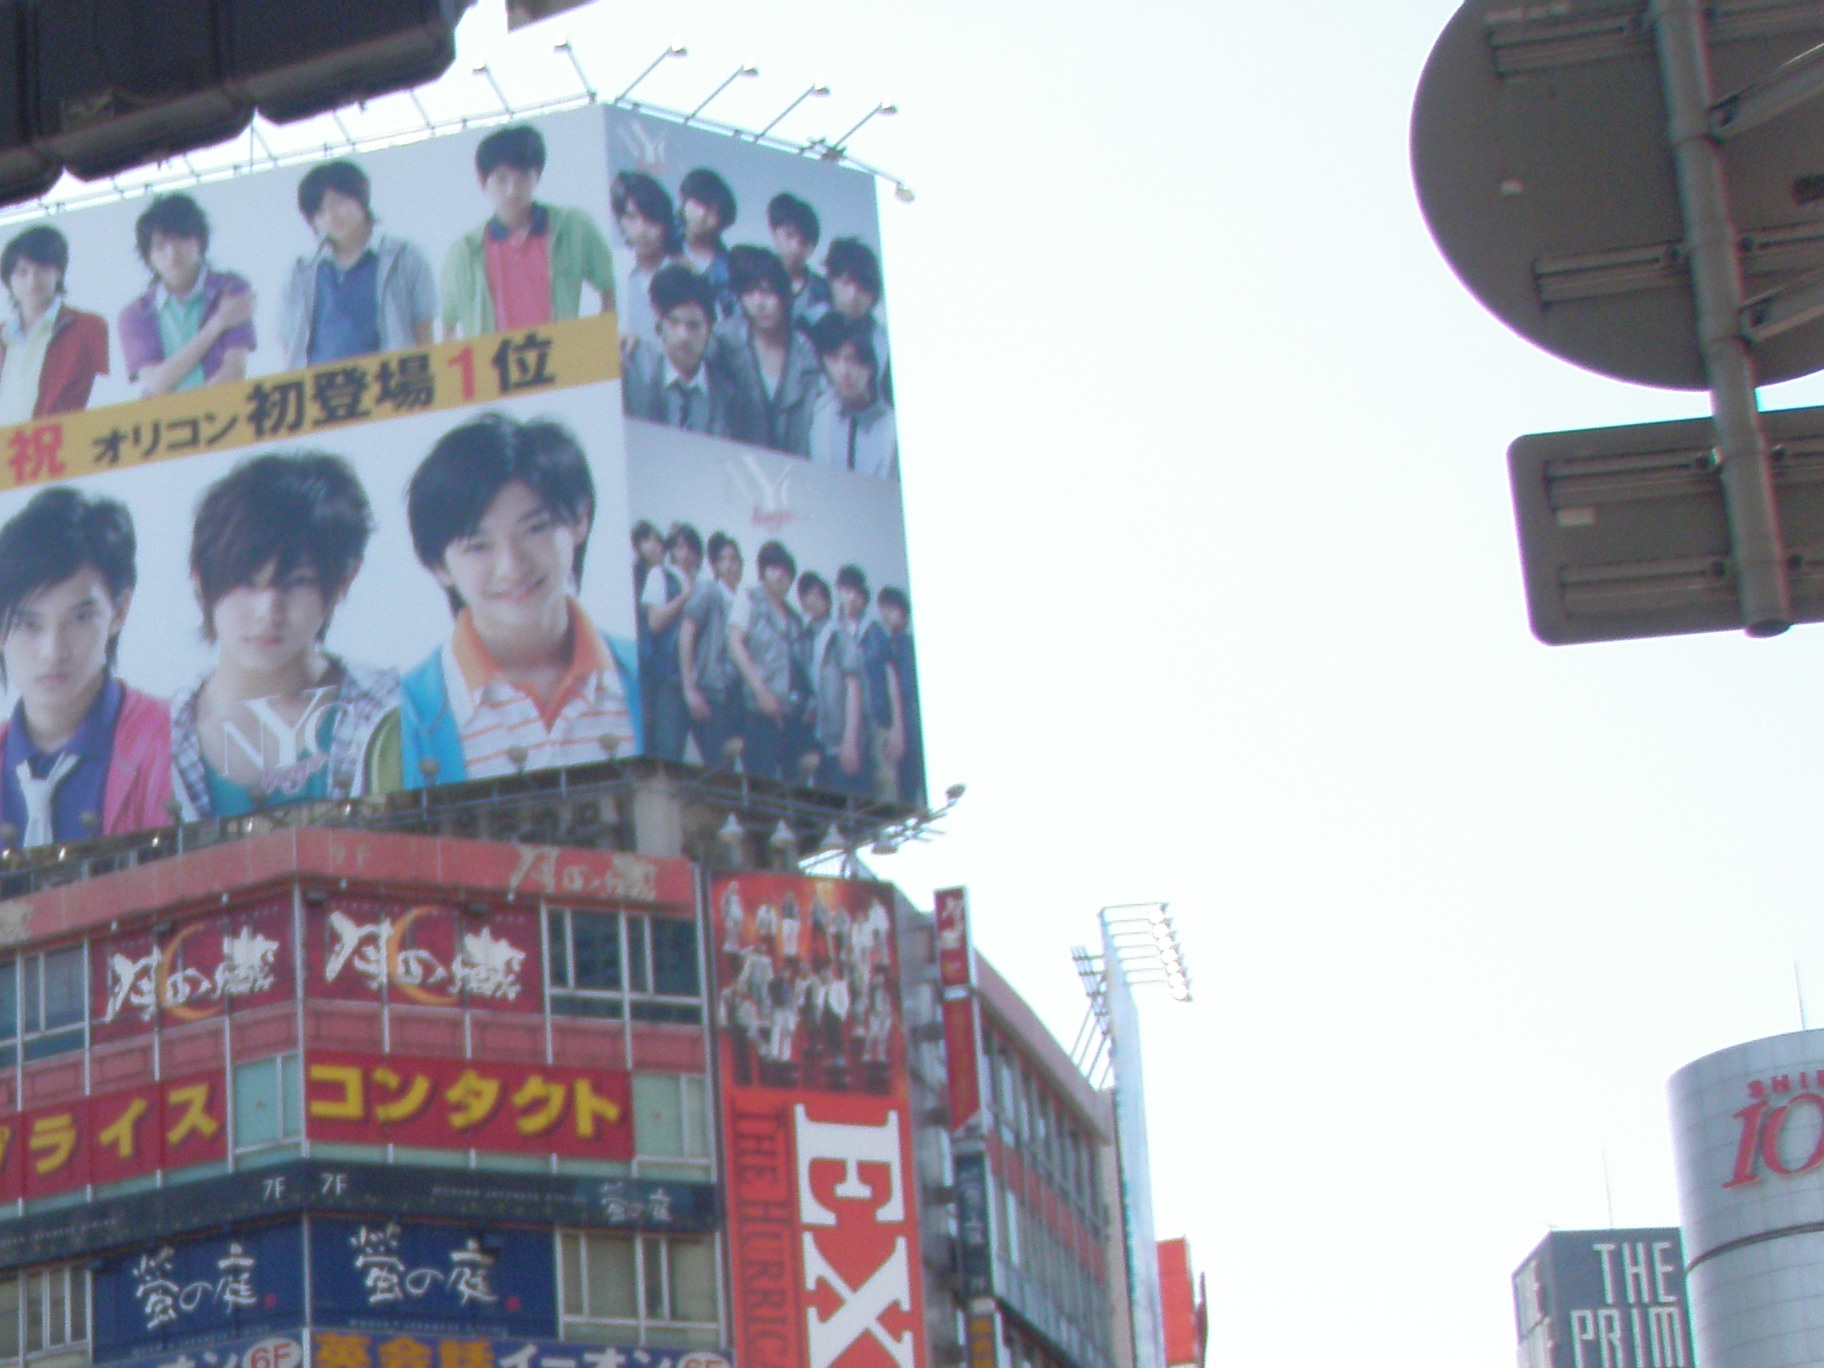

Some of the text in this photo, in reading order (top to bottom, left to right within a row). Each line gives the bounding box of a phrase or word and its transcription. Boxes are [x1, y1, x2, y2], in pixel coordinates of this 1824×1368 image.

[6, 425, 65, 484] 祝
[309, 1063, 621, 1137] コンタクト
[1747, 1069, 1824, 1099] SHI
[733, 1105, 777, 1189] THE
[263, 1178, 285, 1198] 7F
[321, 1173, 348, 1194] 7F
[1593, 1241, 1675, 1305] THE
